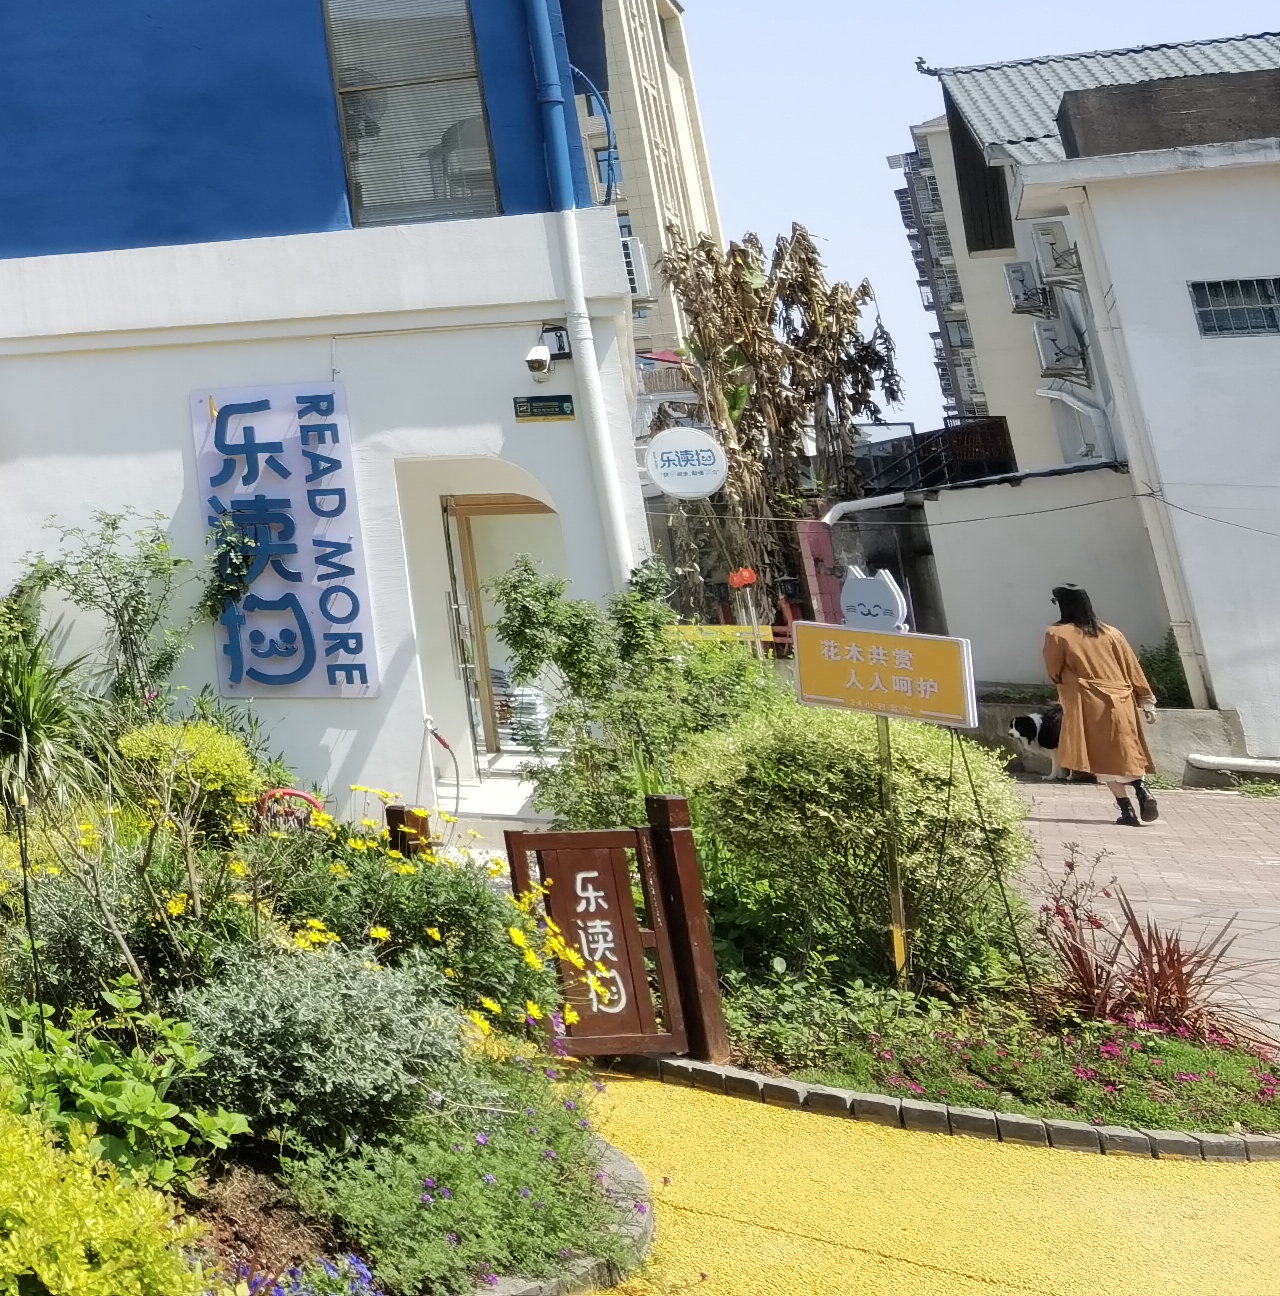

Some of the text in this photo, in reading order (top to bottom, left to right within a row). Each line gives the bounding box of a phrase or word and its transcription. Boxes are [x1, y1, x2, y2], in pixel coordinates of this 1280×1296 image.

[295, 393, 368, 687] READ MORE
[821, 639, 914, 672] 花木共赏
[845, 670, 939, 700] 人人呵护
